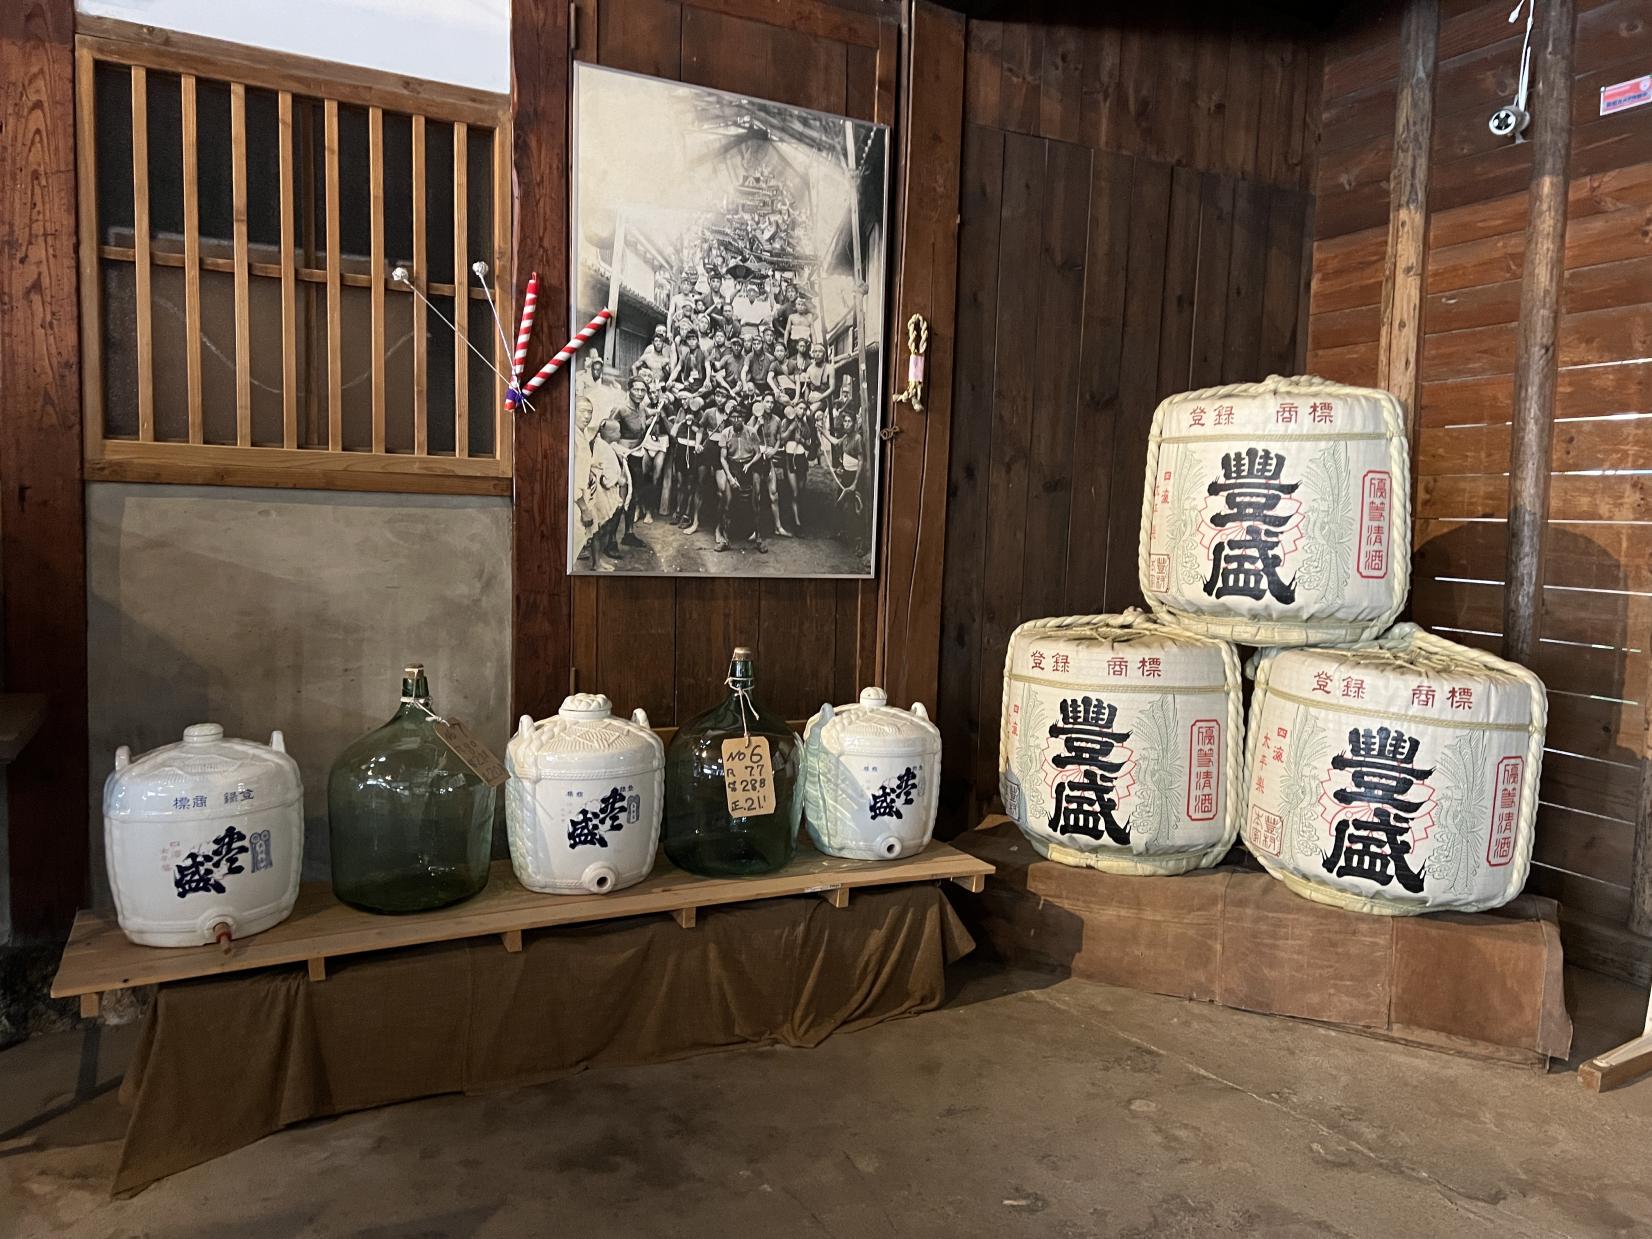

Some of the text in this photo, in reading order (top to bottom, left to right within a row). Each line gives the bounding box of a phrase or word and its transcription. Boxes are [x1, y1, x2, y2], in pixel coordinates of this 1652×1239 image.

[1189, 401, 1334, 428] 登録 商標
[1029, 650, 1163, 679] 登録 商標
[1311, 670, 1474, 711] 登録 商標
[750, 745, 763, 764] 6
